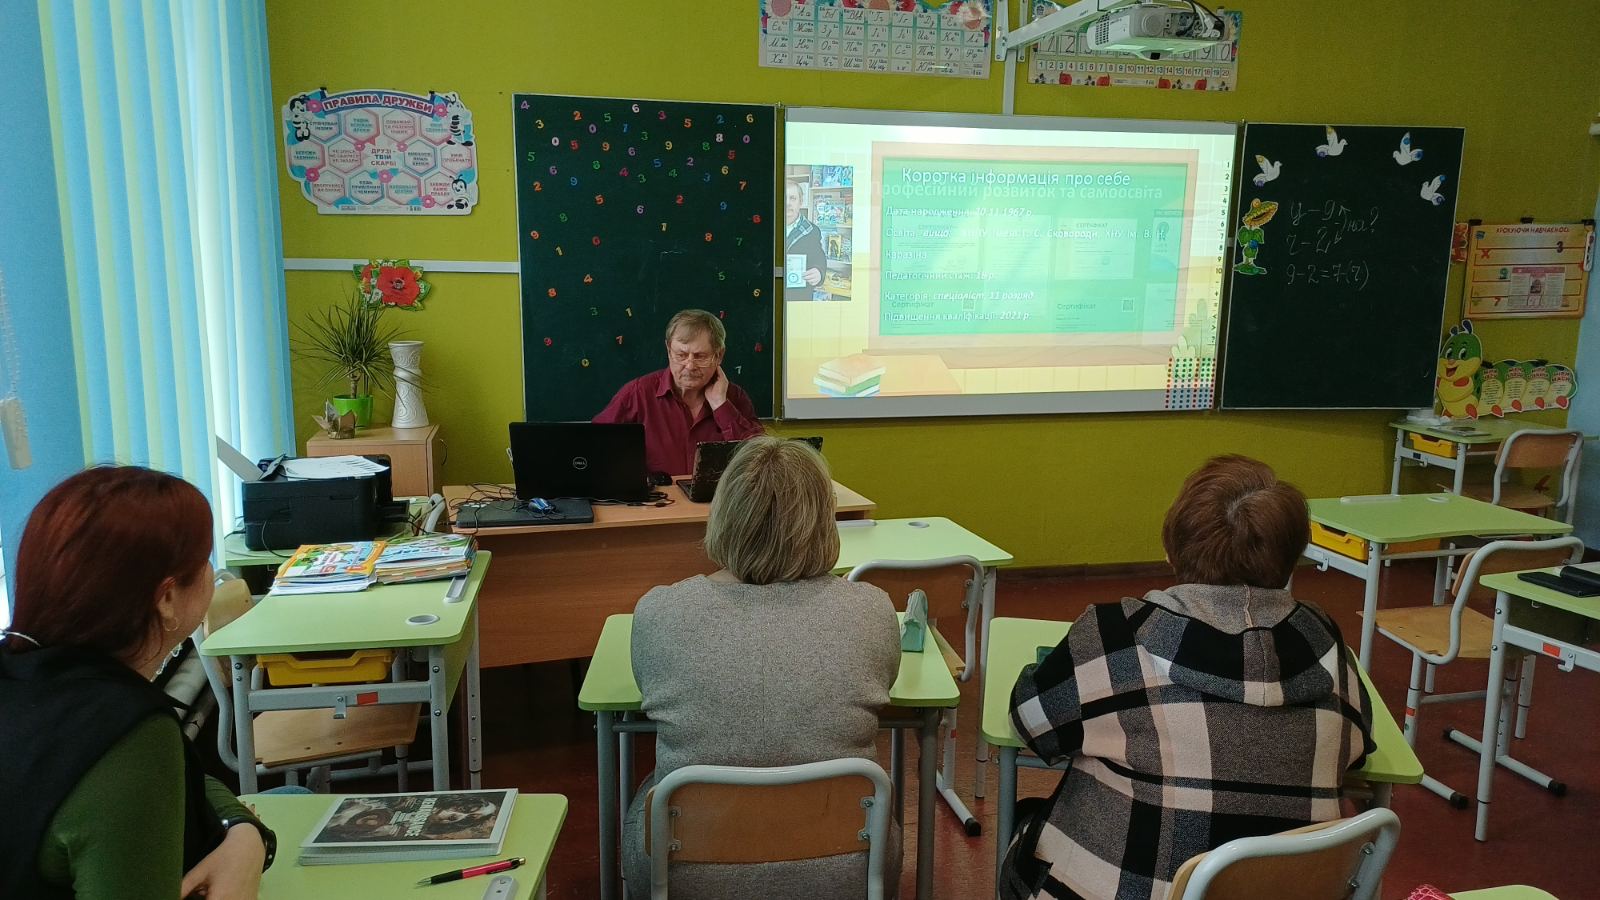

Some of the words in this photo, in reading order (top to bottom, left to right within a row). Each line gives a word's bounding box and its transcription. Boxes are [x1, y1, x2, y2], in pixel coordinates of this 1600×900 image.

[323, 93, 381, 111] ПРАВИЛА
[382, 94, 434, 113] ДРУЖБИ
[902, 167, 967, 185] Коротка
[971, 168, 1059, 187] інформація
[1065, 173, 1093, 187] про
[1097, 170, 1131, 186] себе
[983, 184, 1056, 200] розвиток
[1061, 187, 1075, 198] та
[1080, 186, 1163, 199] самоосвіта
[1556, 240, 1564, 253] 3
